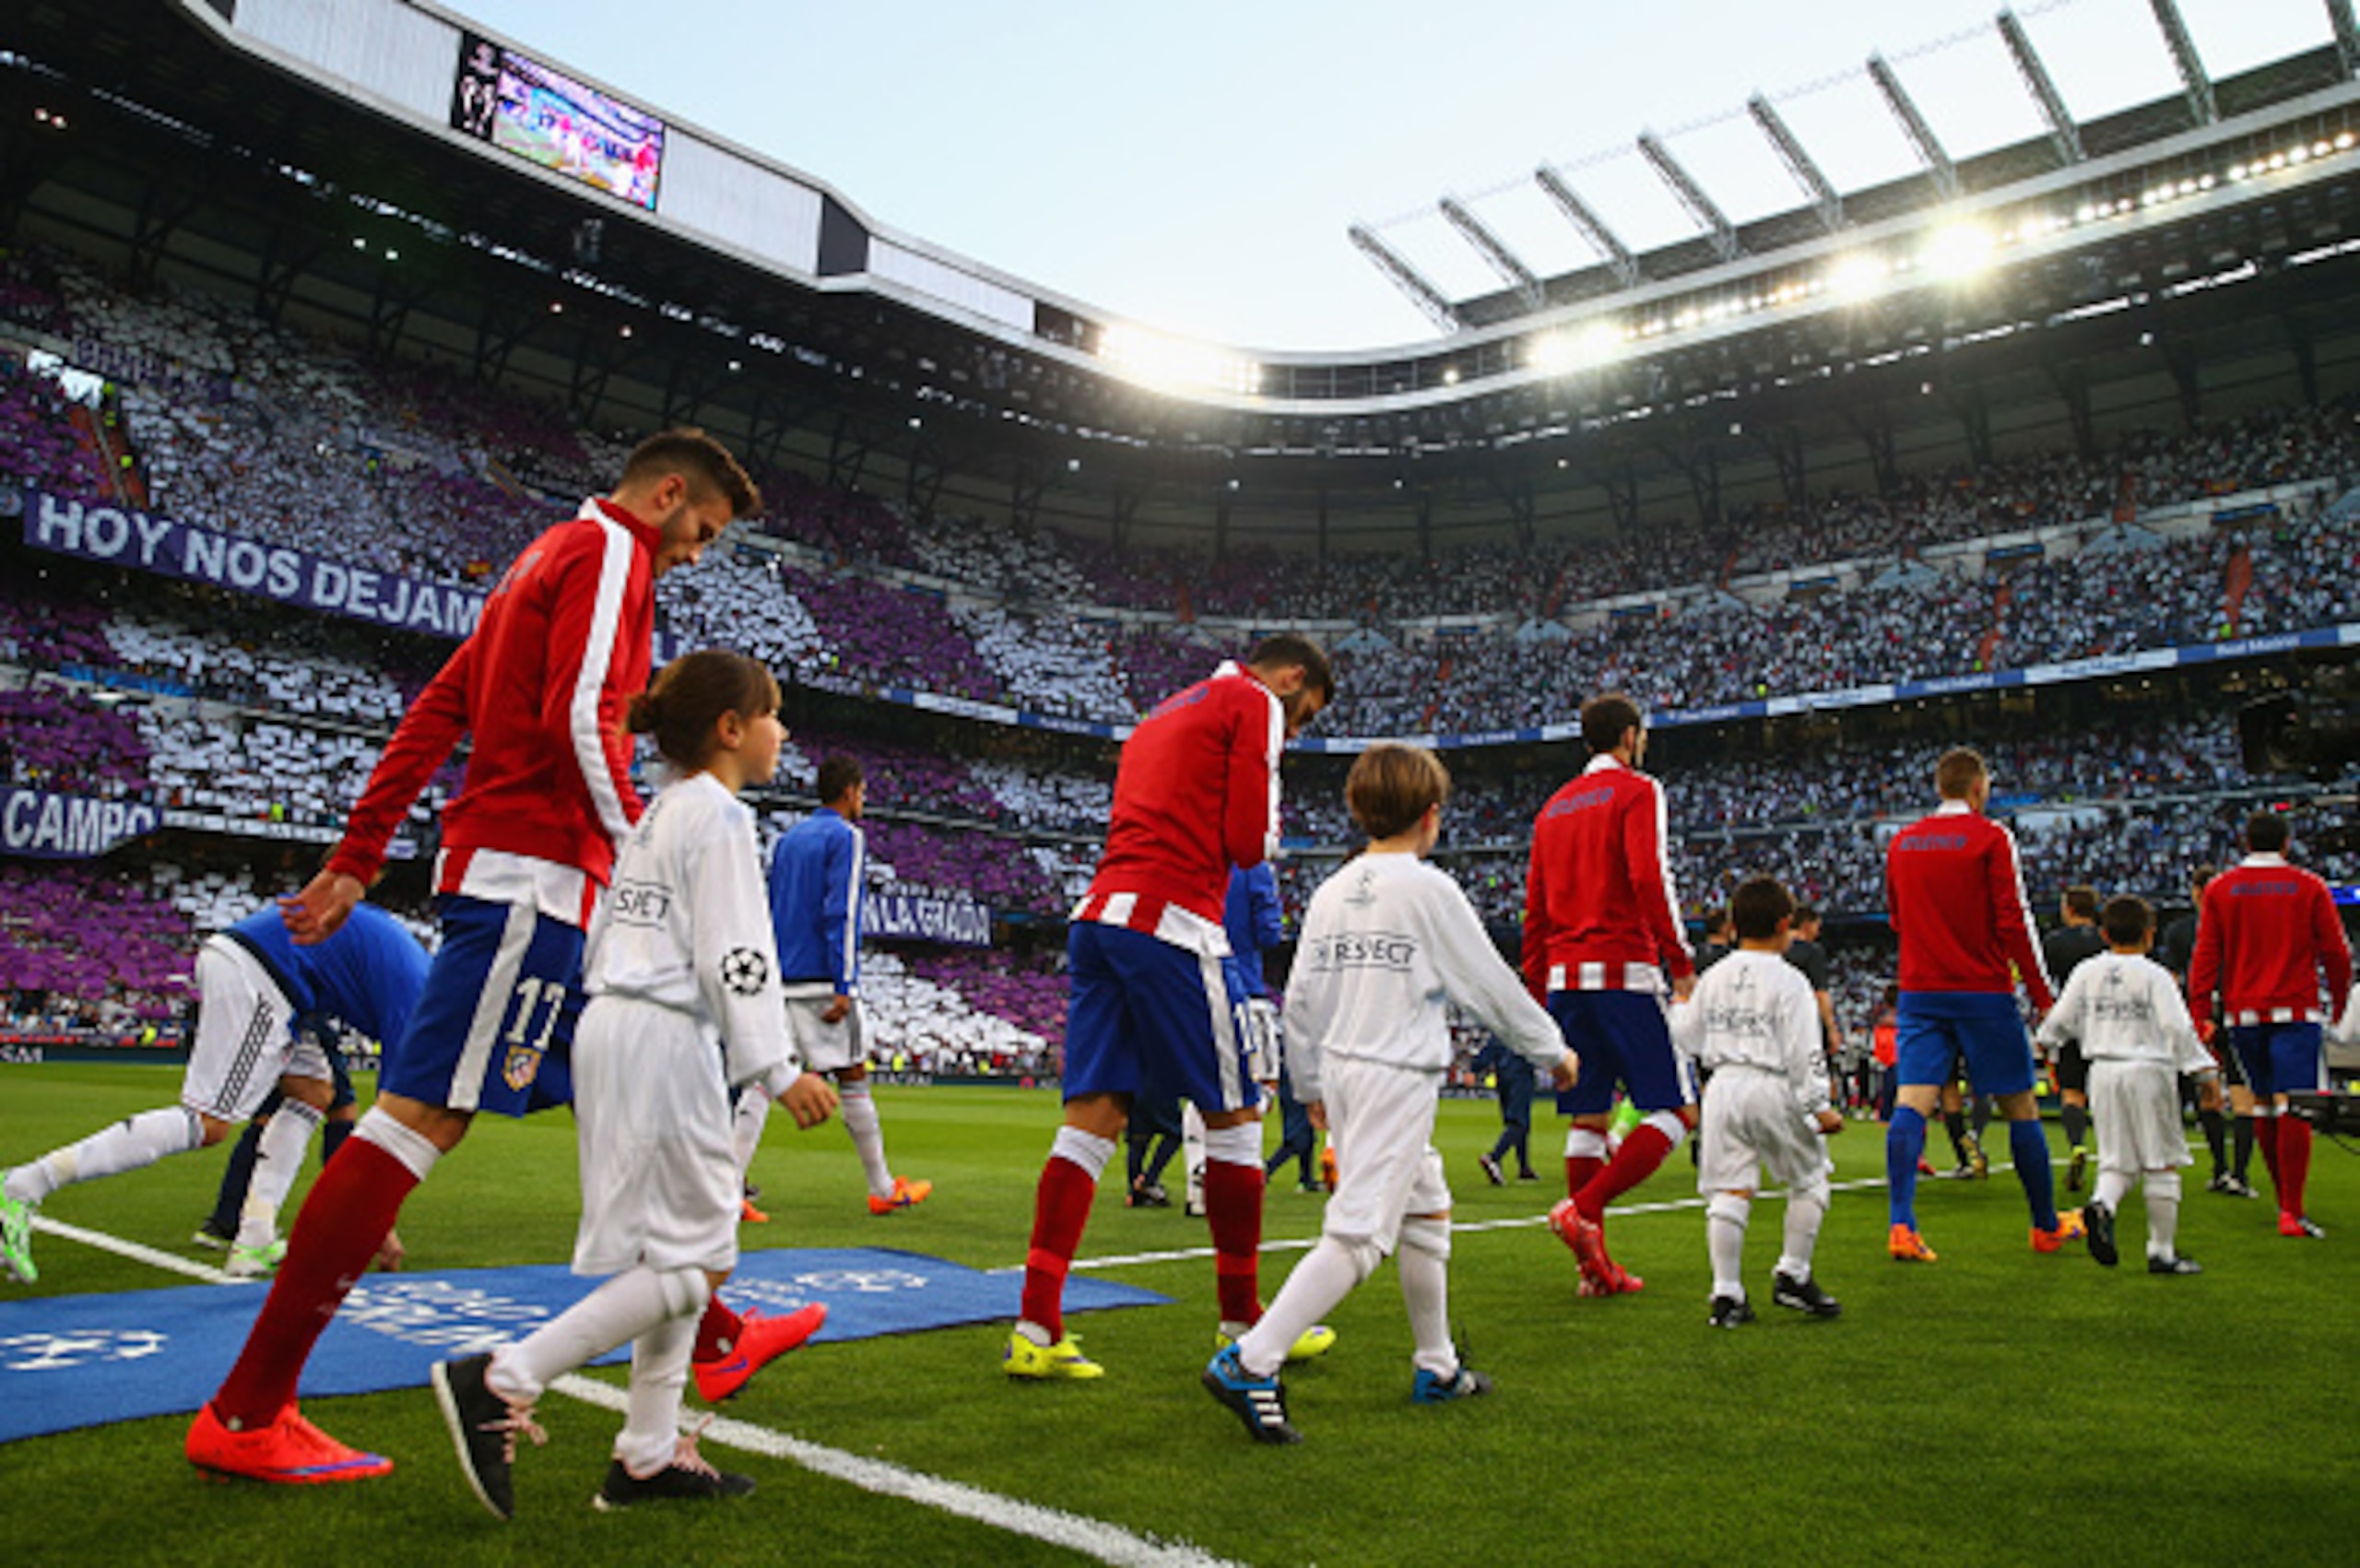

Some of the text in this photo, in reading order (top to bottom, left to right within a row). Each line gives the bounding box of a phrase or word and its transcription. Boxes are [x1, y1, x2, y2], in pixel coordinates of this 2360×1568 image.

[39, 492, 173, 566] HOY
[183, 528, 301, 597] NOS
[313, 560, 485, 635] DEJAM
